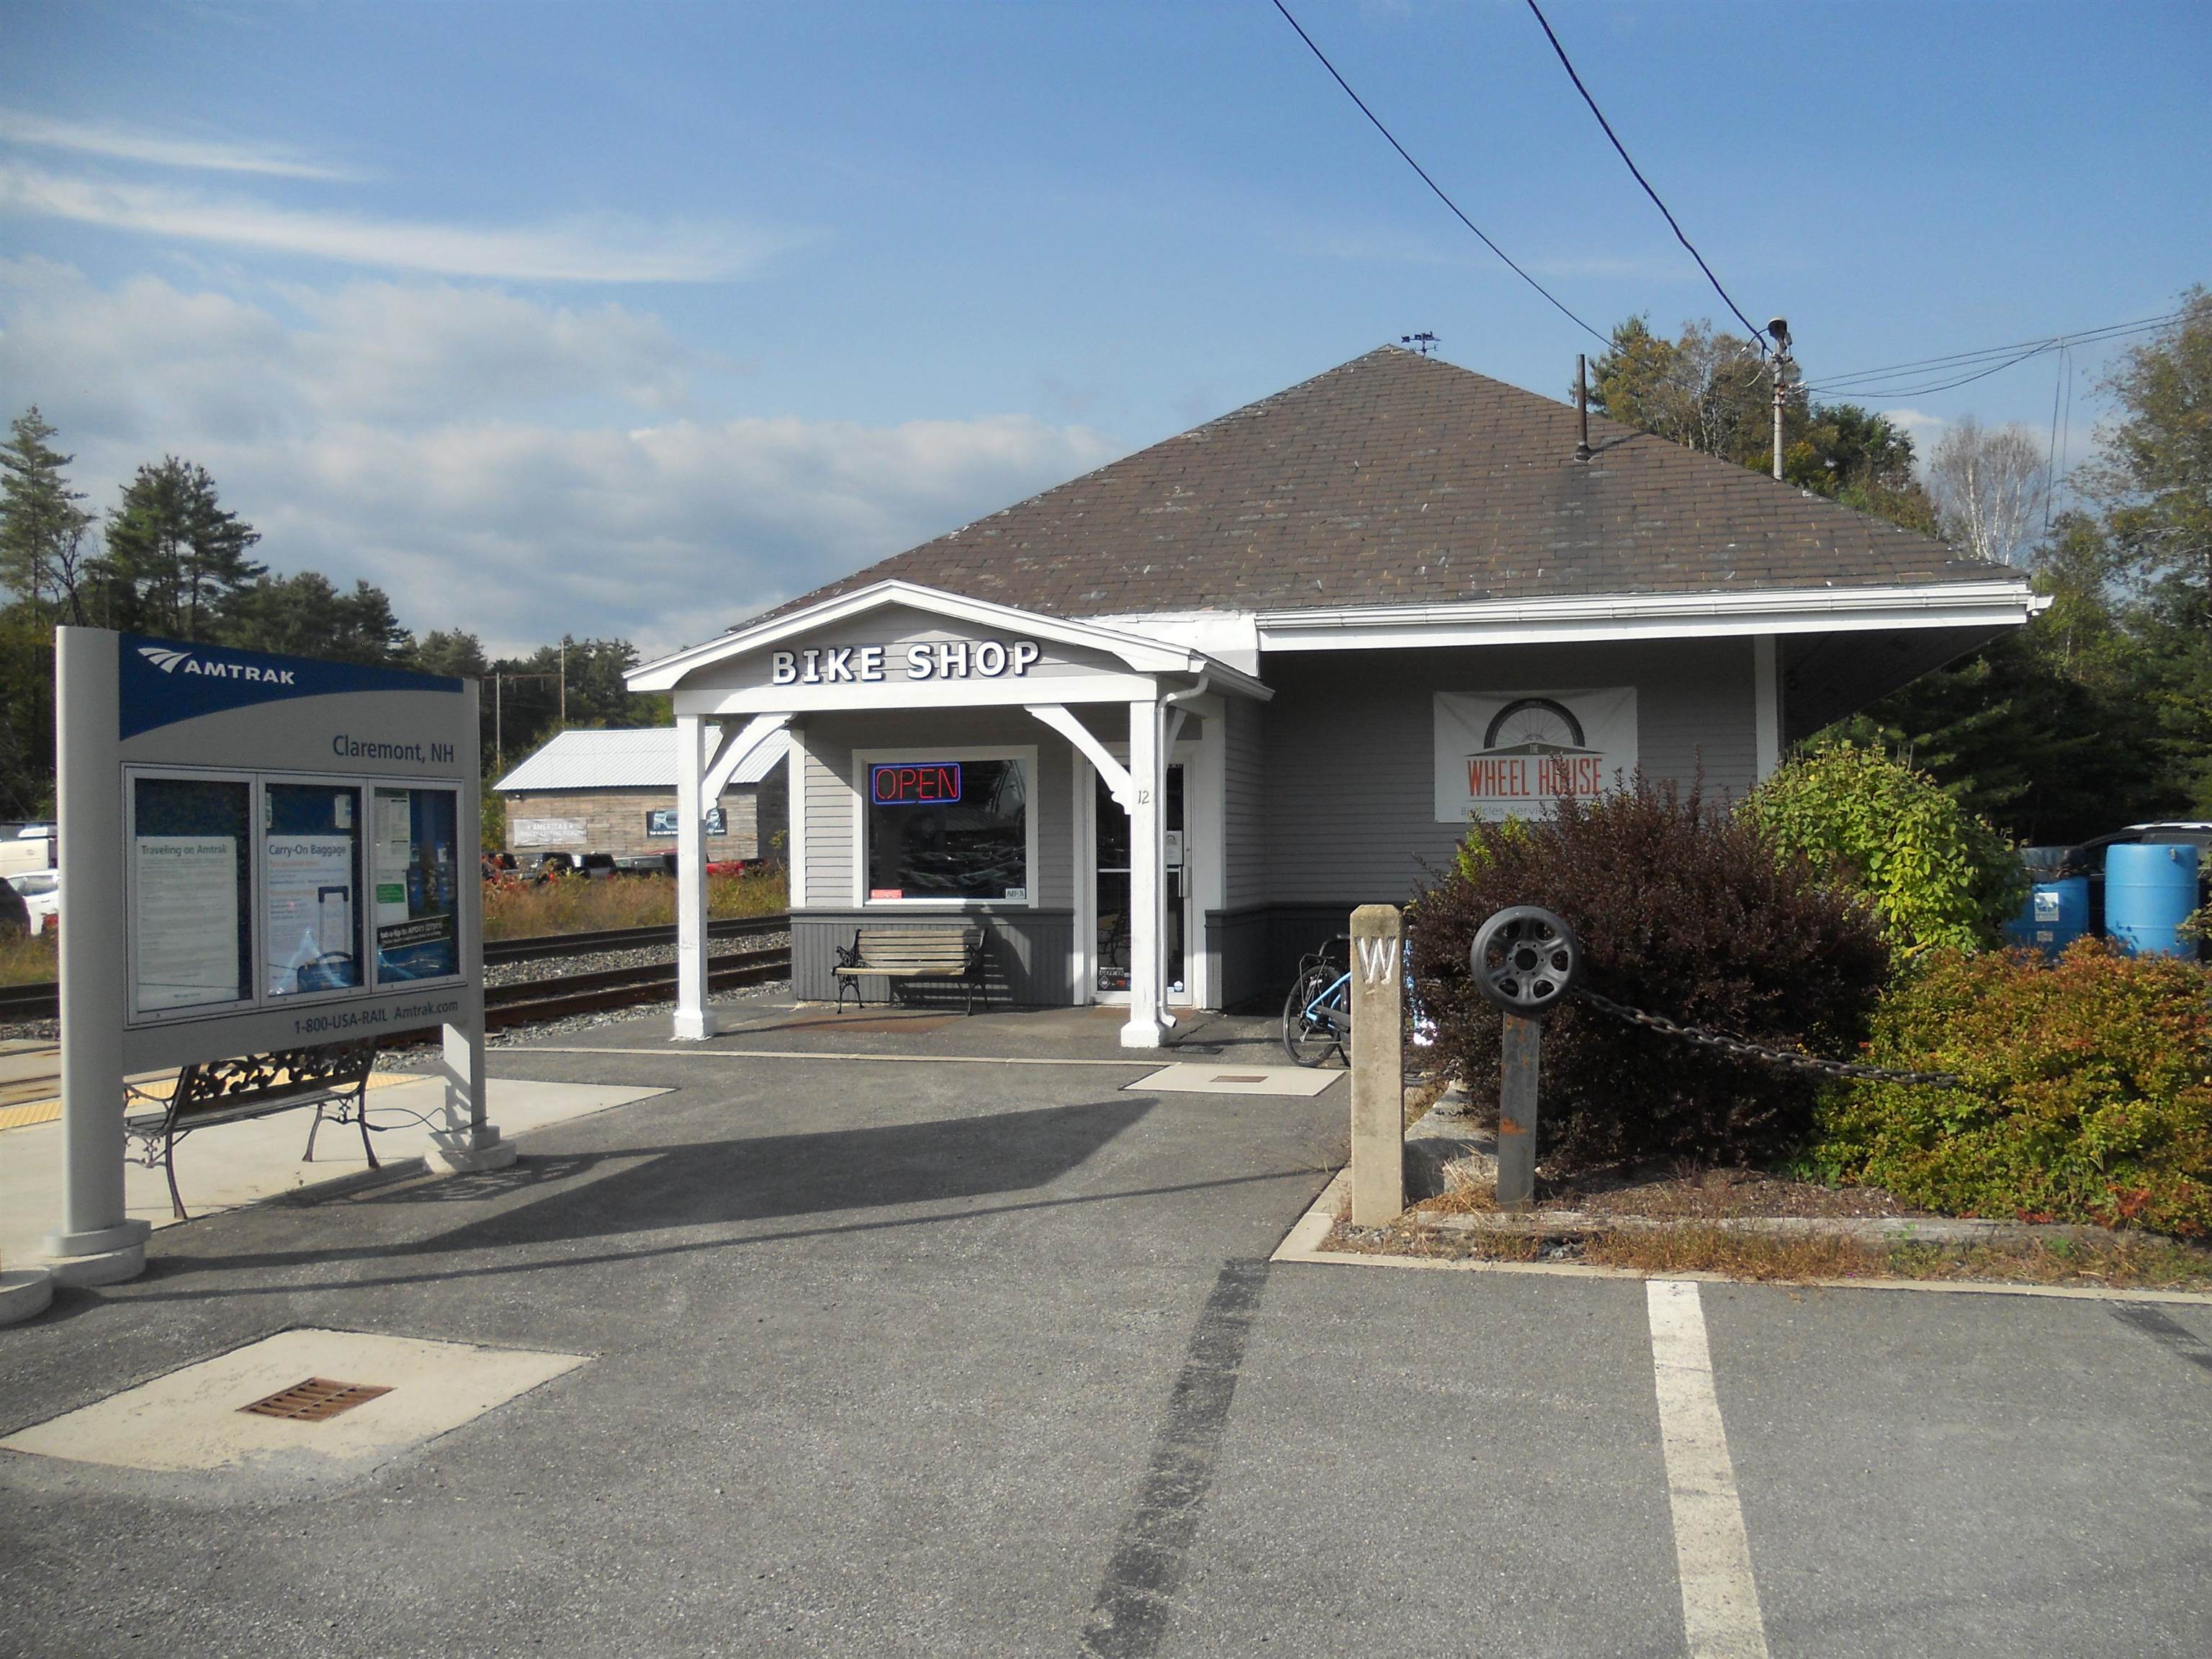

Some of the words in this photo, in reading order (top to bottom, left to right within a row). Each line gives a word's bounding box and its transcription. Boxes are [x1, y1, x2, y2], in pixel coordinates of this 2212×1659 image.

[184, 660, 295, 685] AMTRAK
[773, 647, 885, 685] BIKE
[906, 641, 1039, 679] SHOP
[333, 734, 426, 764] Claremont,
[431, 742, 454, 763] NH
[876, 767, 958, 799] OPEN
[1467, 760, 1529, 796] WHEEL
[1138, 790, 1151, 805] 12
[141, 845, 181, 857] Traveling
[197, 845, 228, 854] Amtrak
[269, 845, 308, 857] Carry-On
[311, 845, 346, 857] Baggage
[1354, 936, 1397, 985] W
[295, 1010, 388, 1034] 1-800-USA-RAIL
[394, 1000, 459, 1020] Amtrak.com
